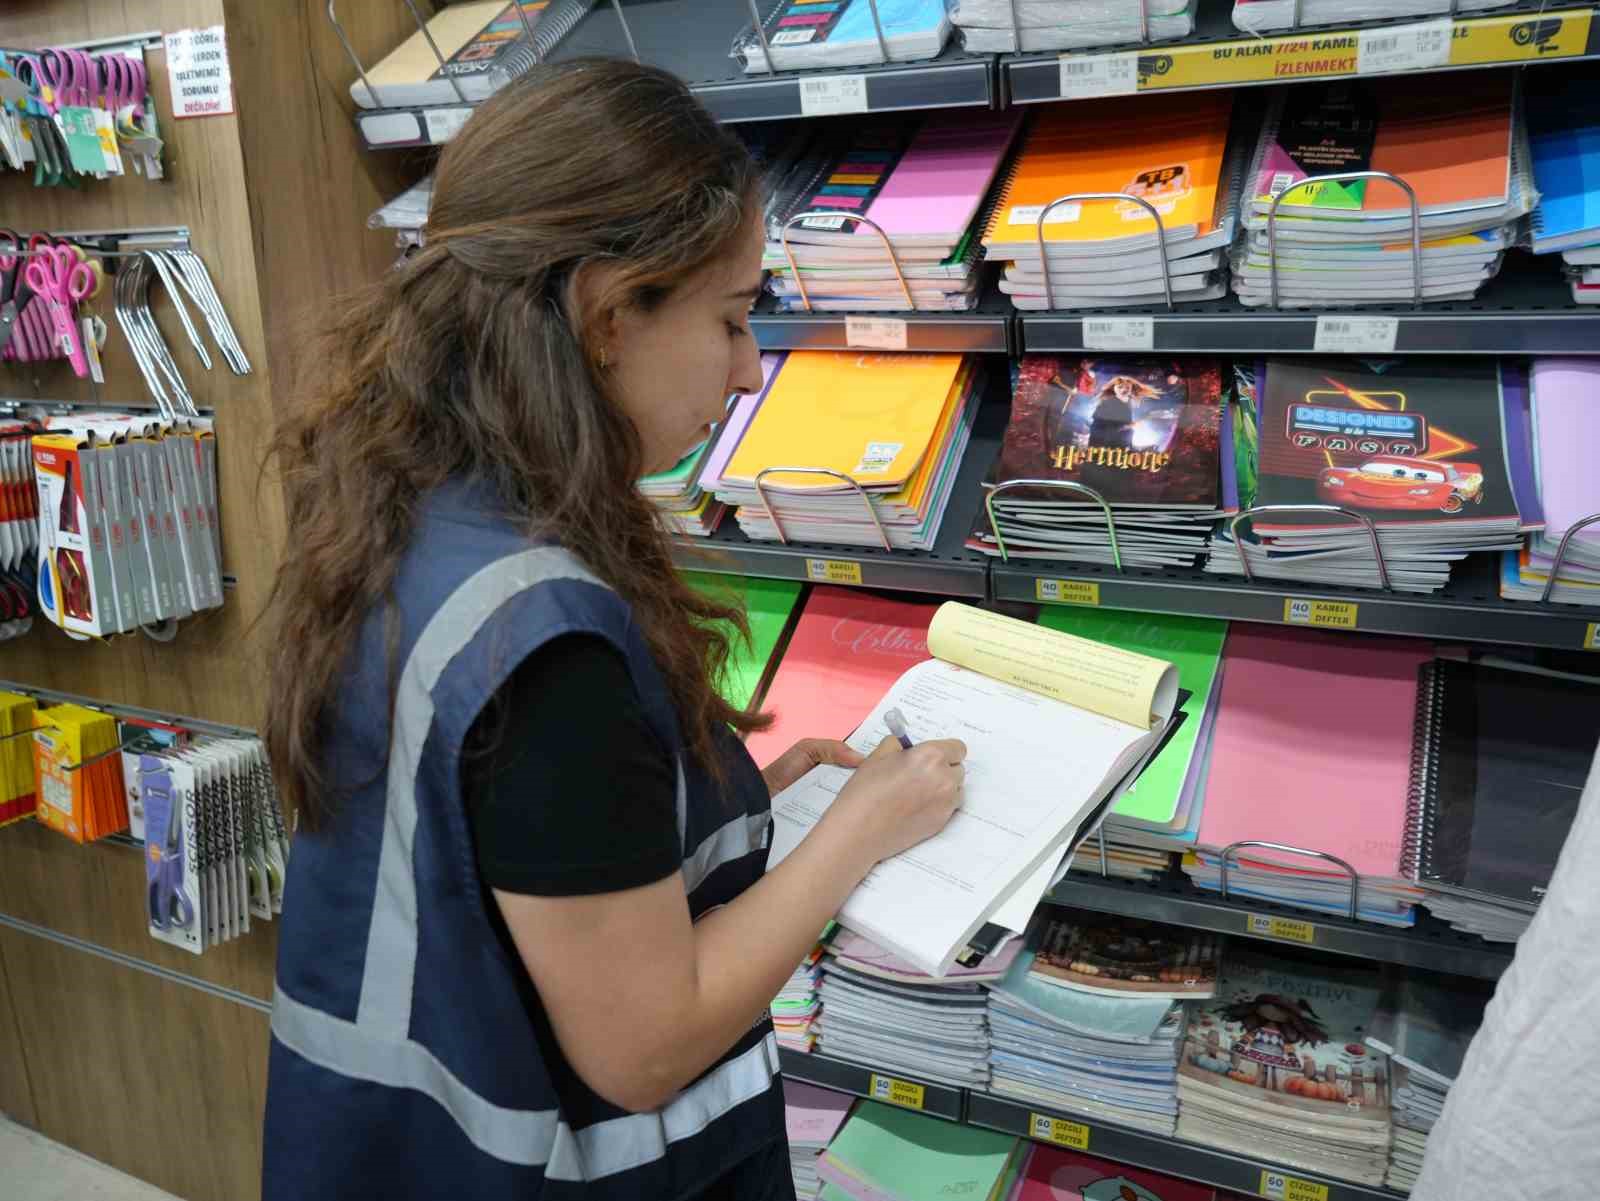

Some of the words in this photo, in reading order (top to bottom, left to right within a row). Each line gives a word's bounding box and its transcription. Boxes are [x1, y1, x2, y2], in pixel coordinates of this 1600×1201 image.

[1213, 48, 1233, 59] BU
[1235, 45, 1274, 57] ALAN
[1311, 36, 1359, 51] KAME
[1274, 57, 1358, 76] İZLENMEKT
[181, 85, 219, 97] SORUMLU
[1295, 407, 1416, 430] DESIGNED
[1292, 603, 1309, 613] 40
[186, 788, 198, 873] SCISSOR
